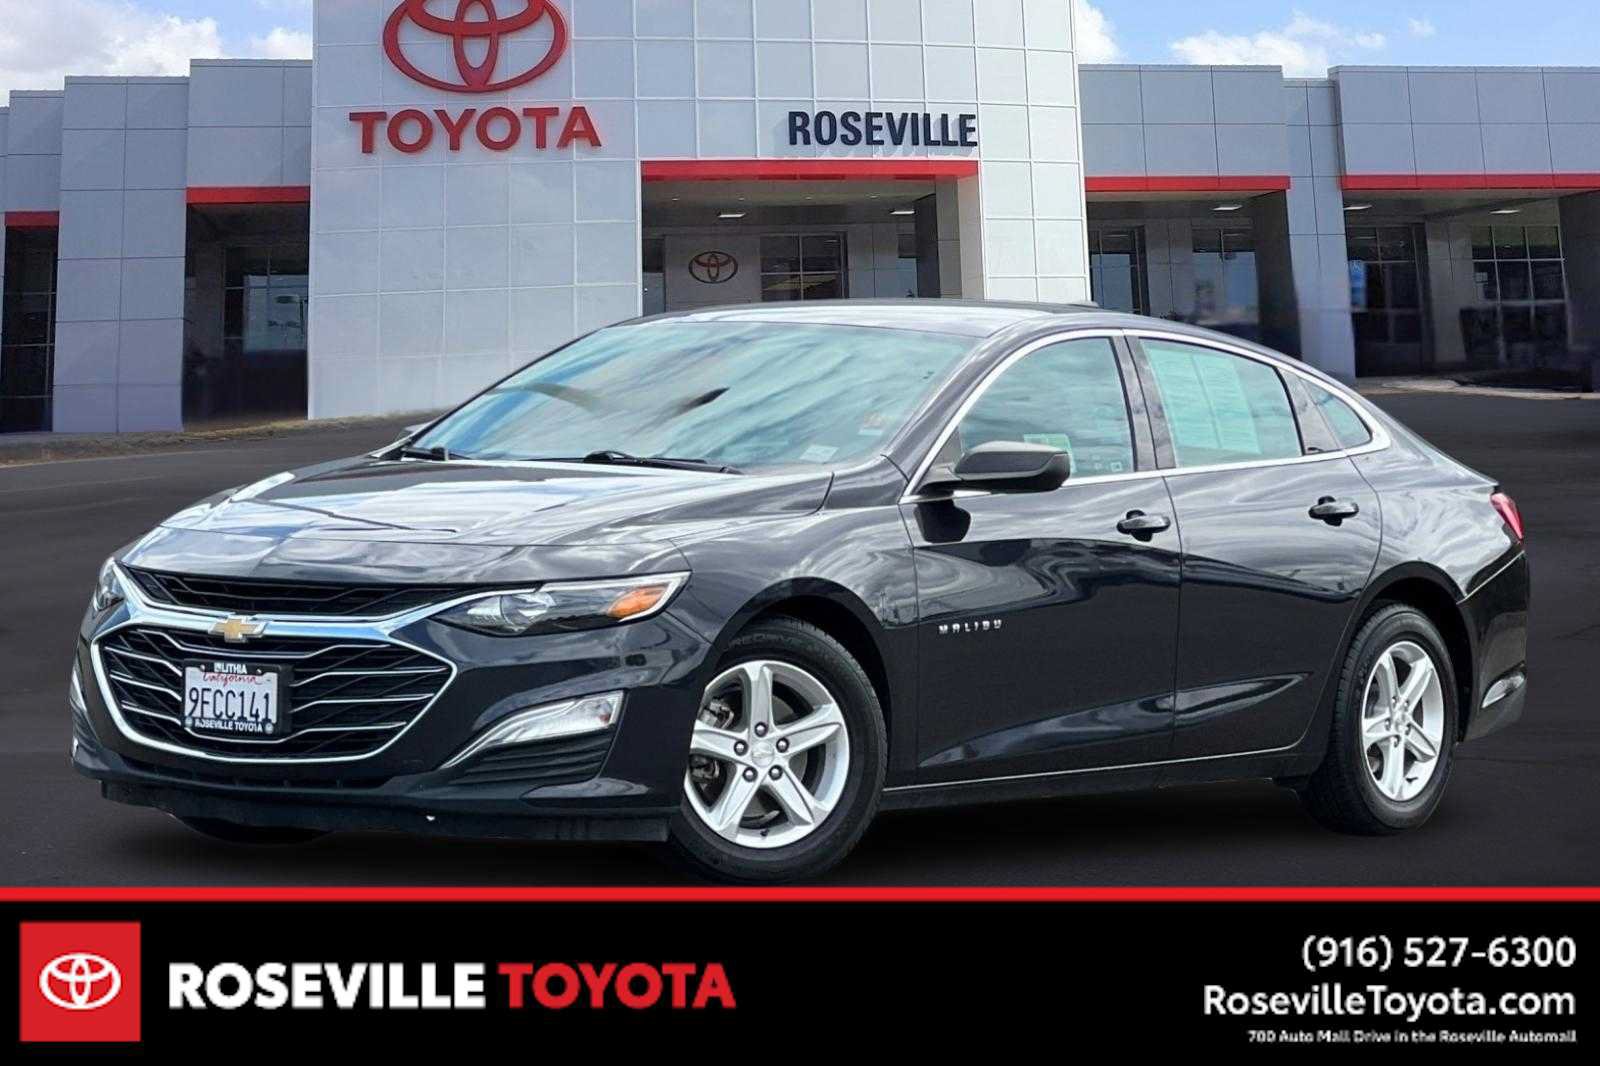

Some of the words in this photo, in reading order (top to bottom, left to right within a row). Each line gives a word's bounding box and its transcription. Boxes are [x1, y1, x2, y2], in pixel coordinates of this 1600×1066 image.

[349, 106, 602, 154] TOYOTA
[788, 111, 978, 147] ROSEVILLE
[939, 619, 1002, 634] MALIBU
[221, 662, 248, 674] LITHIA
[188, 687, 271, 721] 9FCC141
[194, 718, 234, 731] ROSEVILLE
[234, 720, 264, 733] TOYOTA
